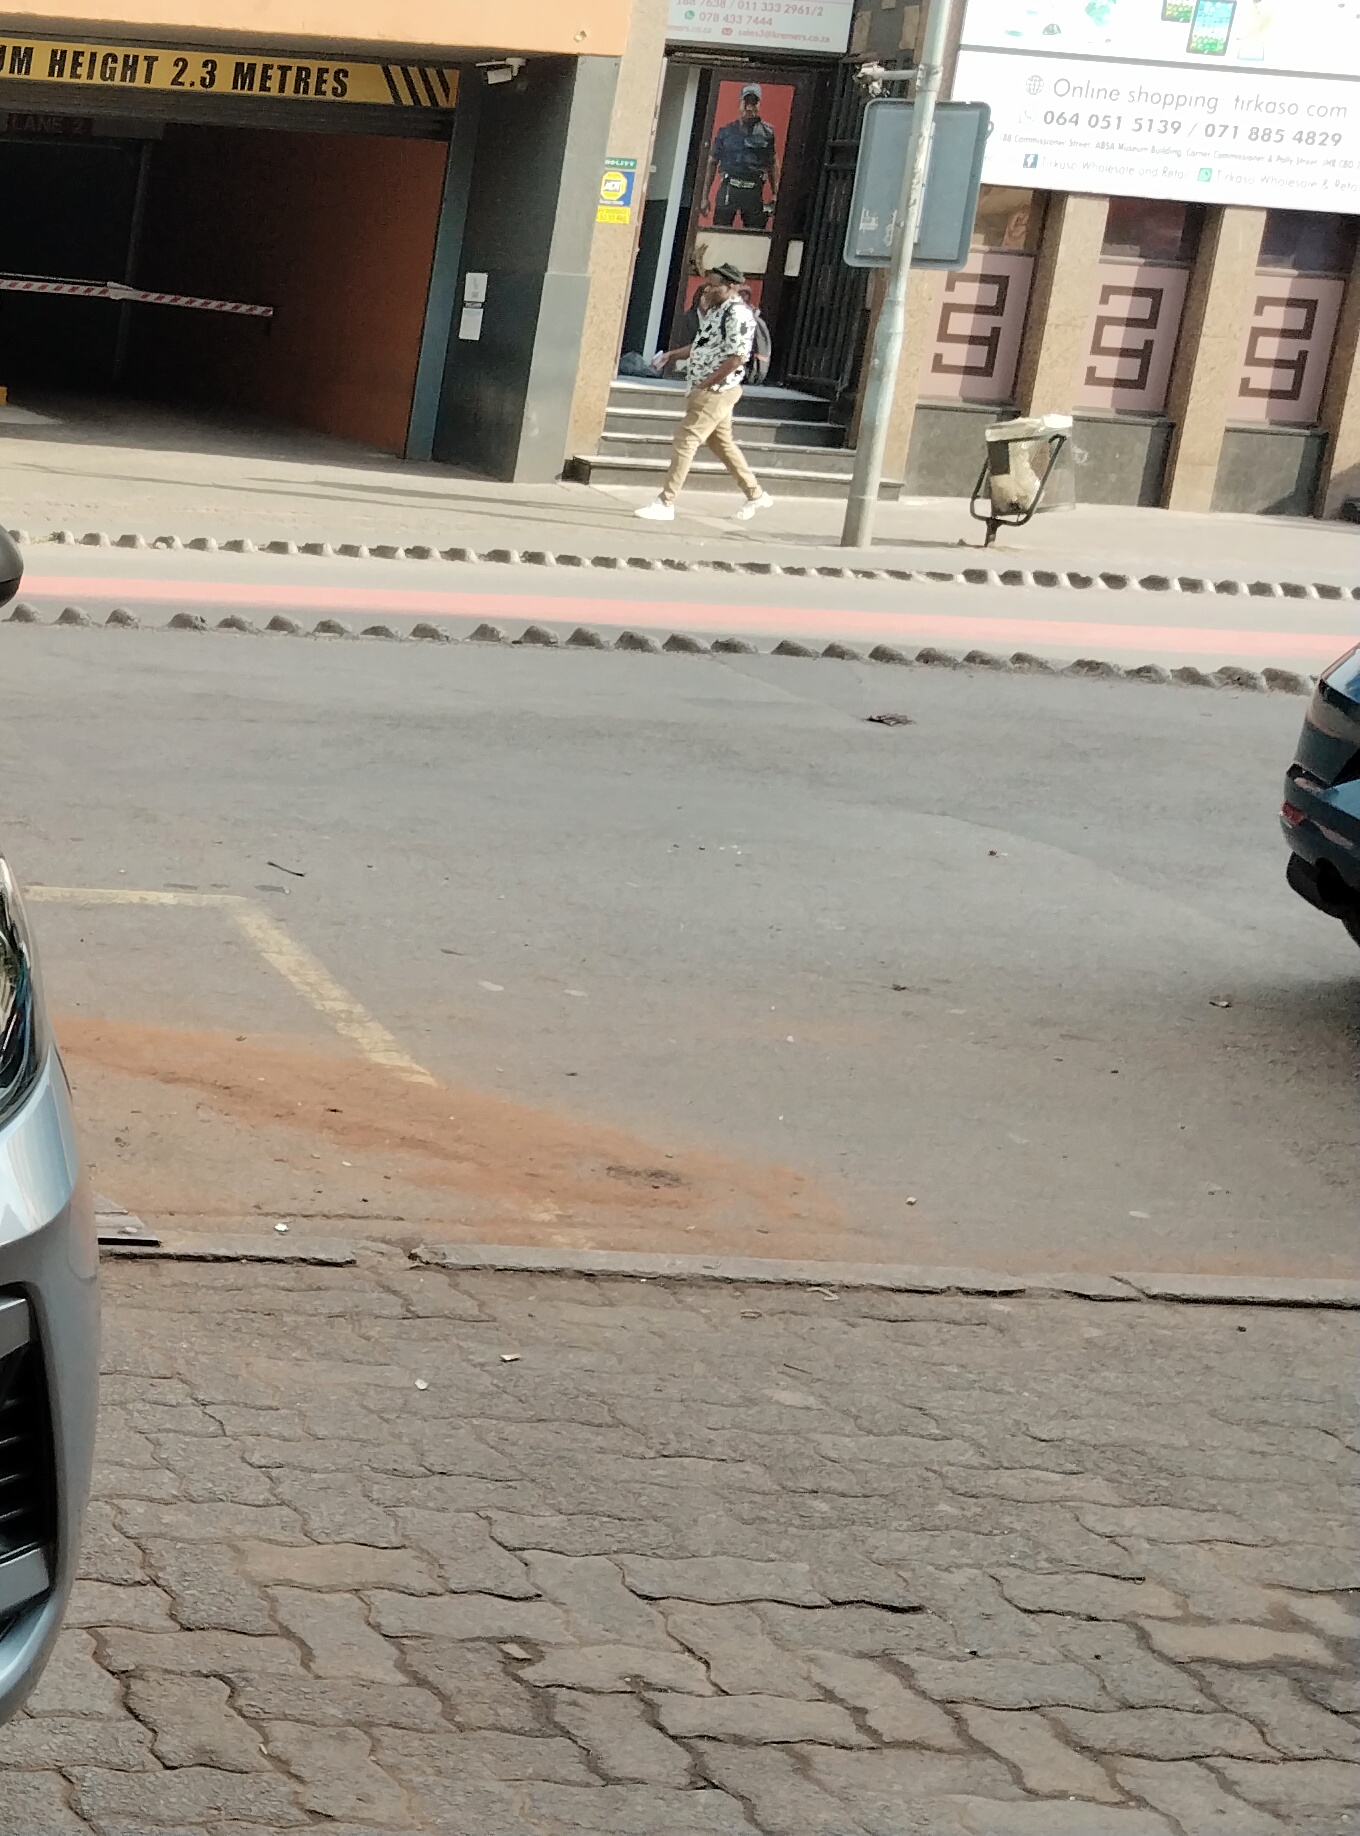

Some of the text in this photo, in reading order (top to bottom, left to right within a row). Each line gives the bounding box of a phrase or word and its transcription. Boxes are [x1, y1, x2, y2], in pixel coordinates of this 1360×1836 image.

[699, 12, 720, 22] 078
[737, 1, 757, 11] 011
[784, 3, 824, 16] 2961/2
[47, 48, 159, 84] HEIGHT
[170, 57, 218, 89] 2.3
[232, 61, 349, 98] METRES
[1053, 78, 1120, 102] Online
[1127, 84, 1218, 115] shopping
[12, 112, 64, 134] LANE
[1043, 110, 1342, 147] 064 051 5139 / 071 885 4829
[1139, 167, 1158, 177] and
